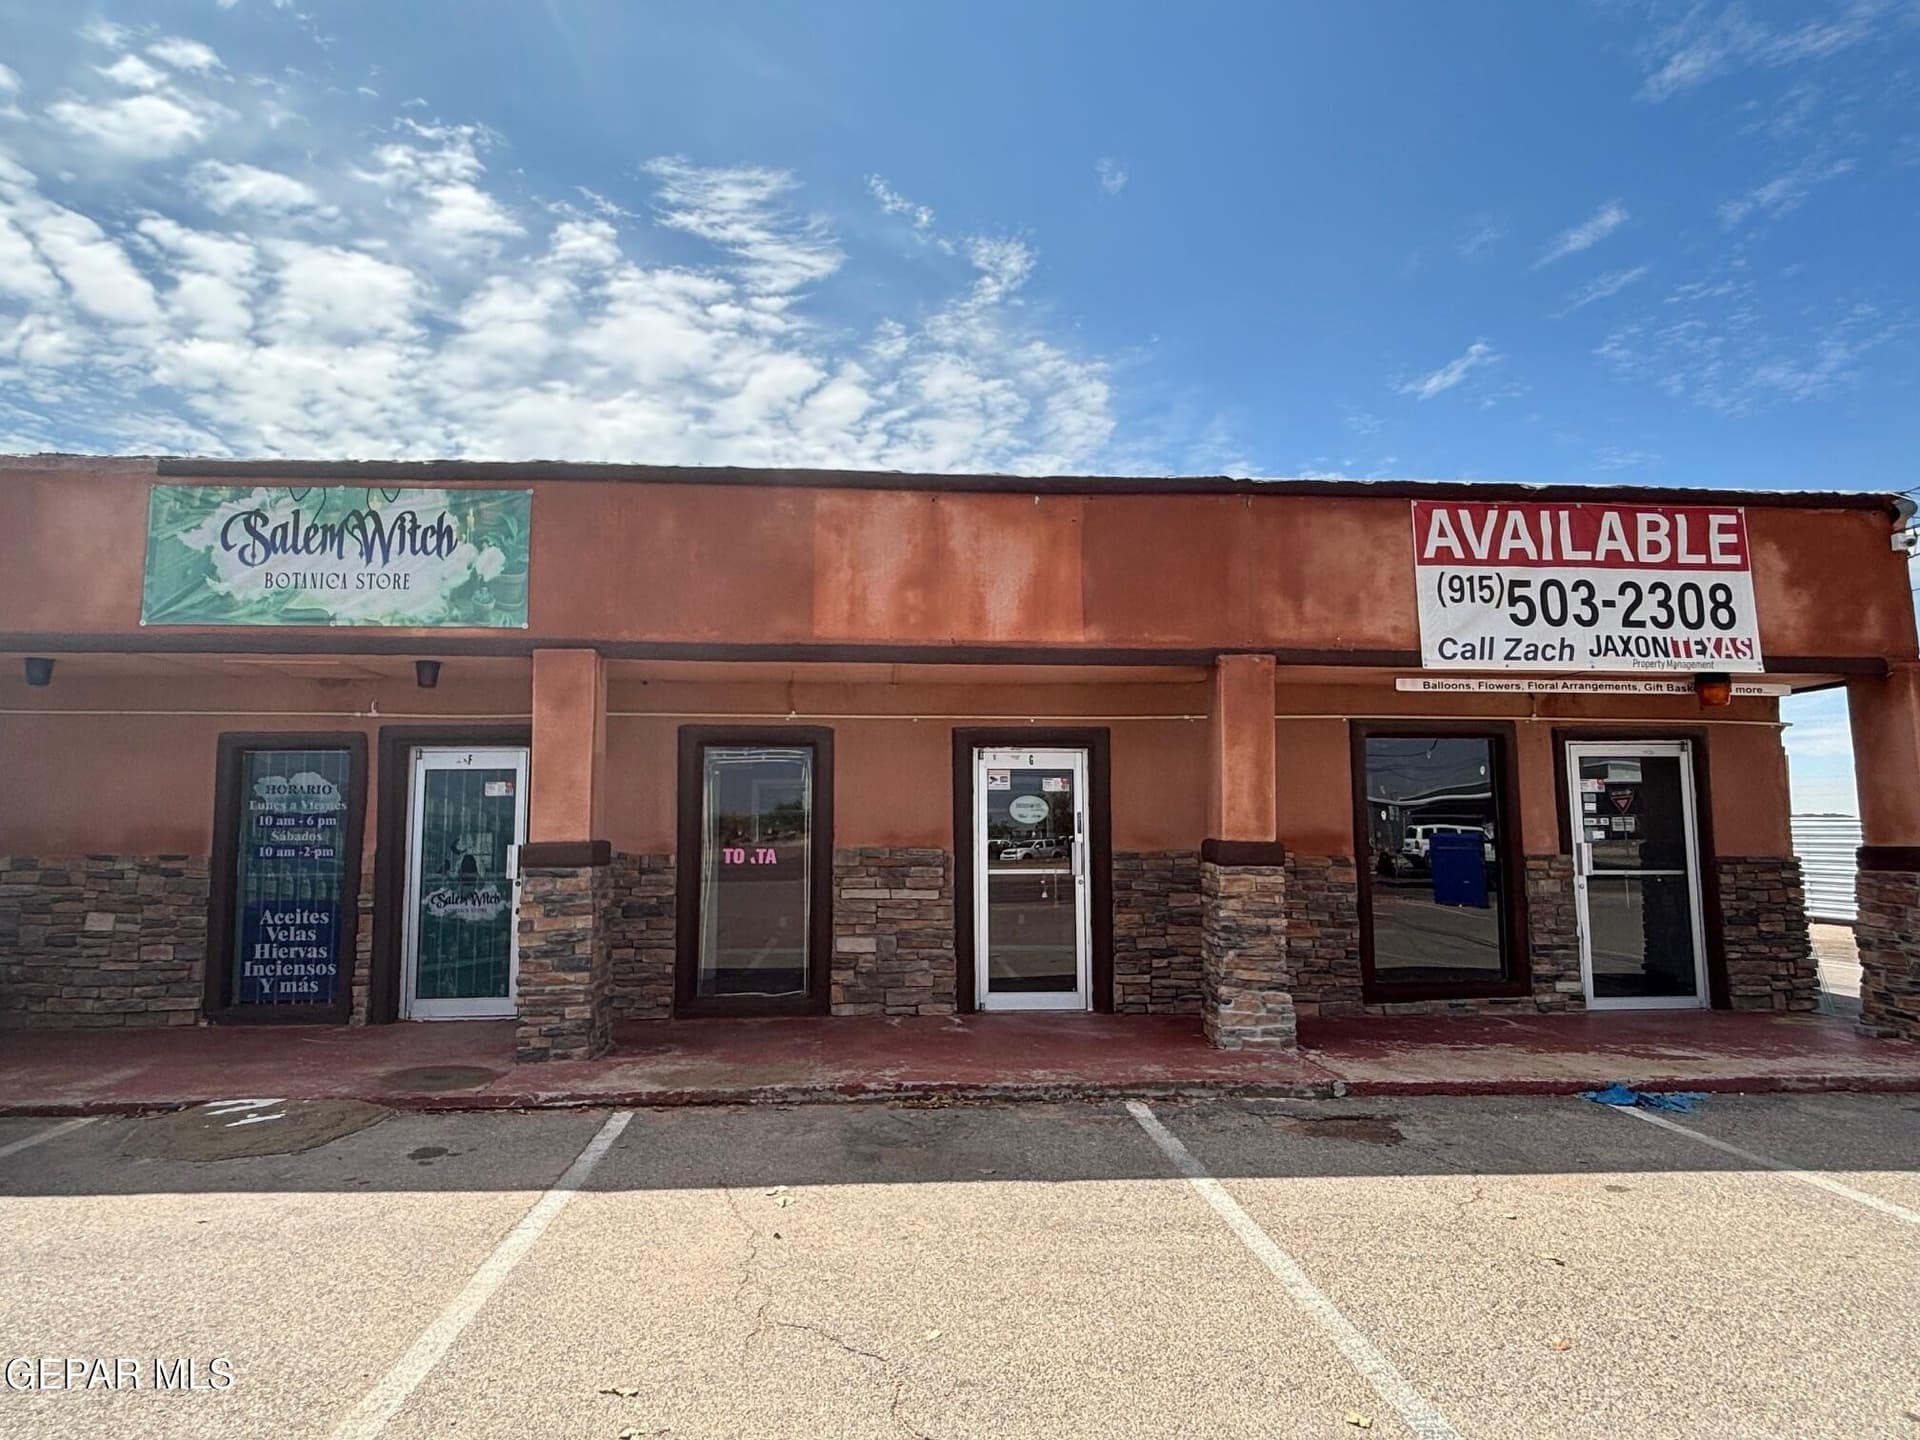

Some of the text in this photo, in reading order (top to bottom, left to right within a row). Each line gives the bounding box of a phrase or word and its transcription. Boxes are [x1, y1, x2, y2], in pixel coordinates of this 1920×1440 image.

[220, 508, 458, 568] Salem Witch
[1423, 508, 1742, 565] AVAILABLE
[264, 571, 411, 590] BOTANICA STORE
[1507, 578, 1737, 631] 503-2308
[1438, 636, 1495, 661] Call
[1503, 637, 1576, 662] Zach
[1632, 659, 1715, 670] Property Management
[1422, 681, 1475, 691] Balloons,
[1478, 681, 1525, 692] Flowers,
[1527, 681, 1558, 691] Floral
[1561, 681, 1641, 693] Arrangements,
[1644, 683, 1665, 692] Gift
[265, 784, 333, 795] HORARIO
[259, 815, 273, 826] 10
[276, 816, 295, 826] am
[306, 815, 315, 826] 6
[318, 816, 337, 828] pm
[271, 830, 322, 841] Sábados
[259, 846, 273, 857] 10
[276, 848, 295, 857] am
[723, 848, 777, 864] TOTA
[259, 908, 330, 925] Aceites
[265, 926, 317, 942] Velas
[253, 943, 328, 959] Hiervas
[243, 960, 337, 977] Inciensos
[260, 976, 319, 994] Y más
